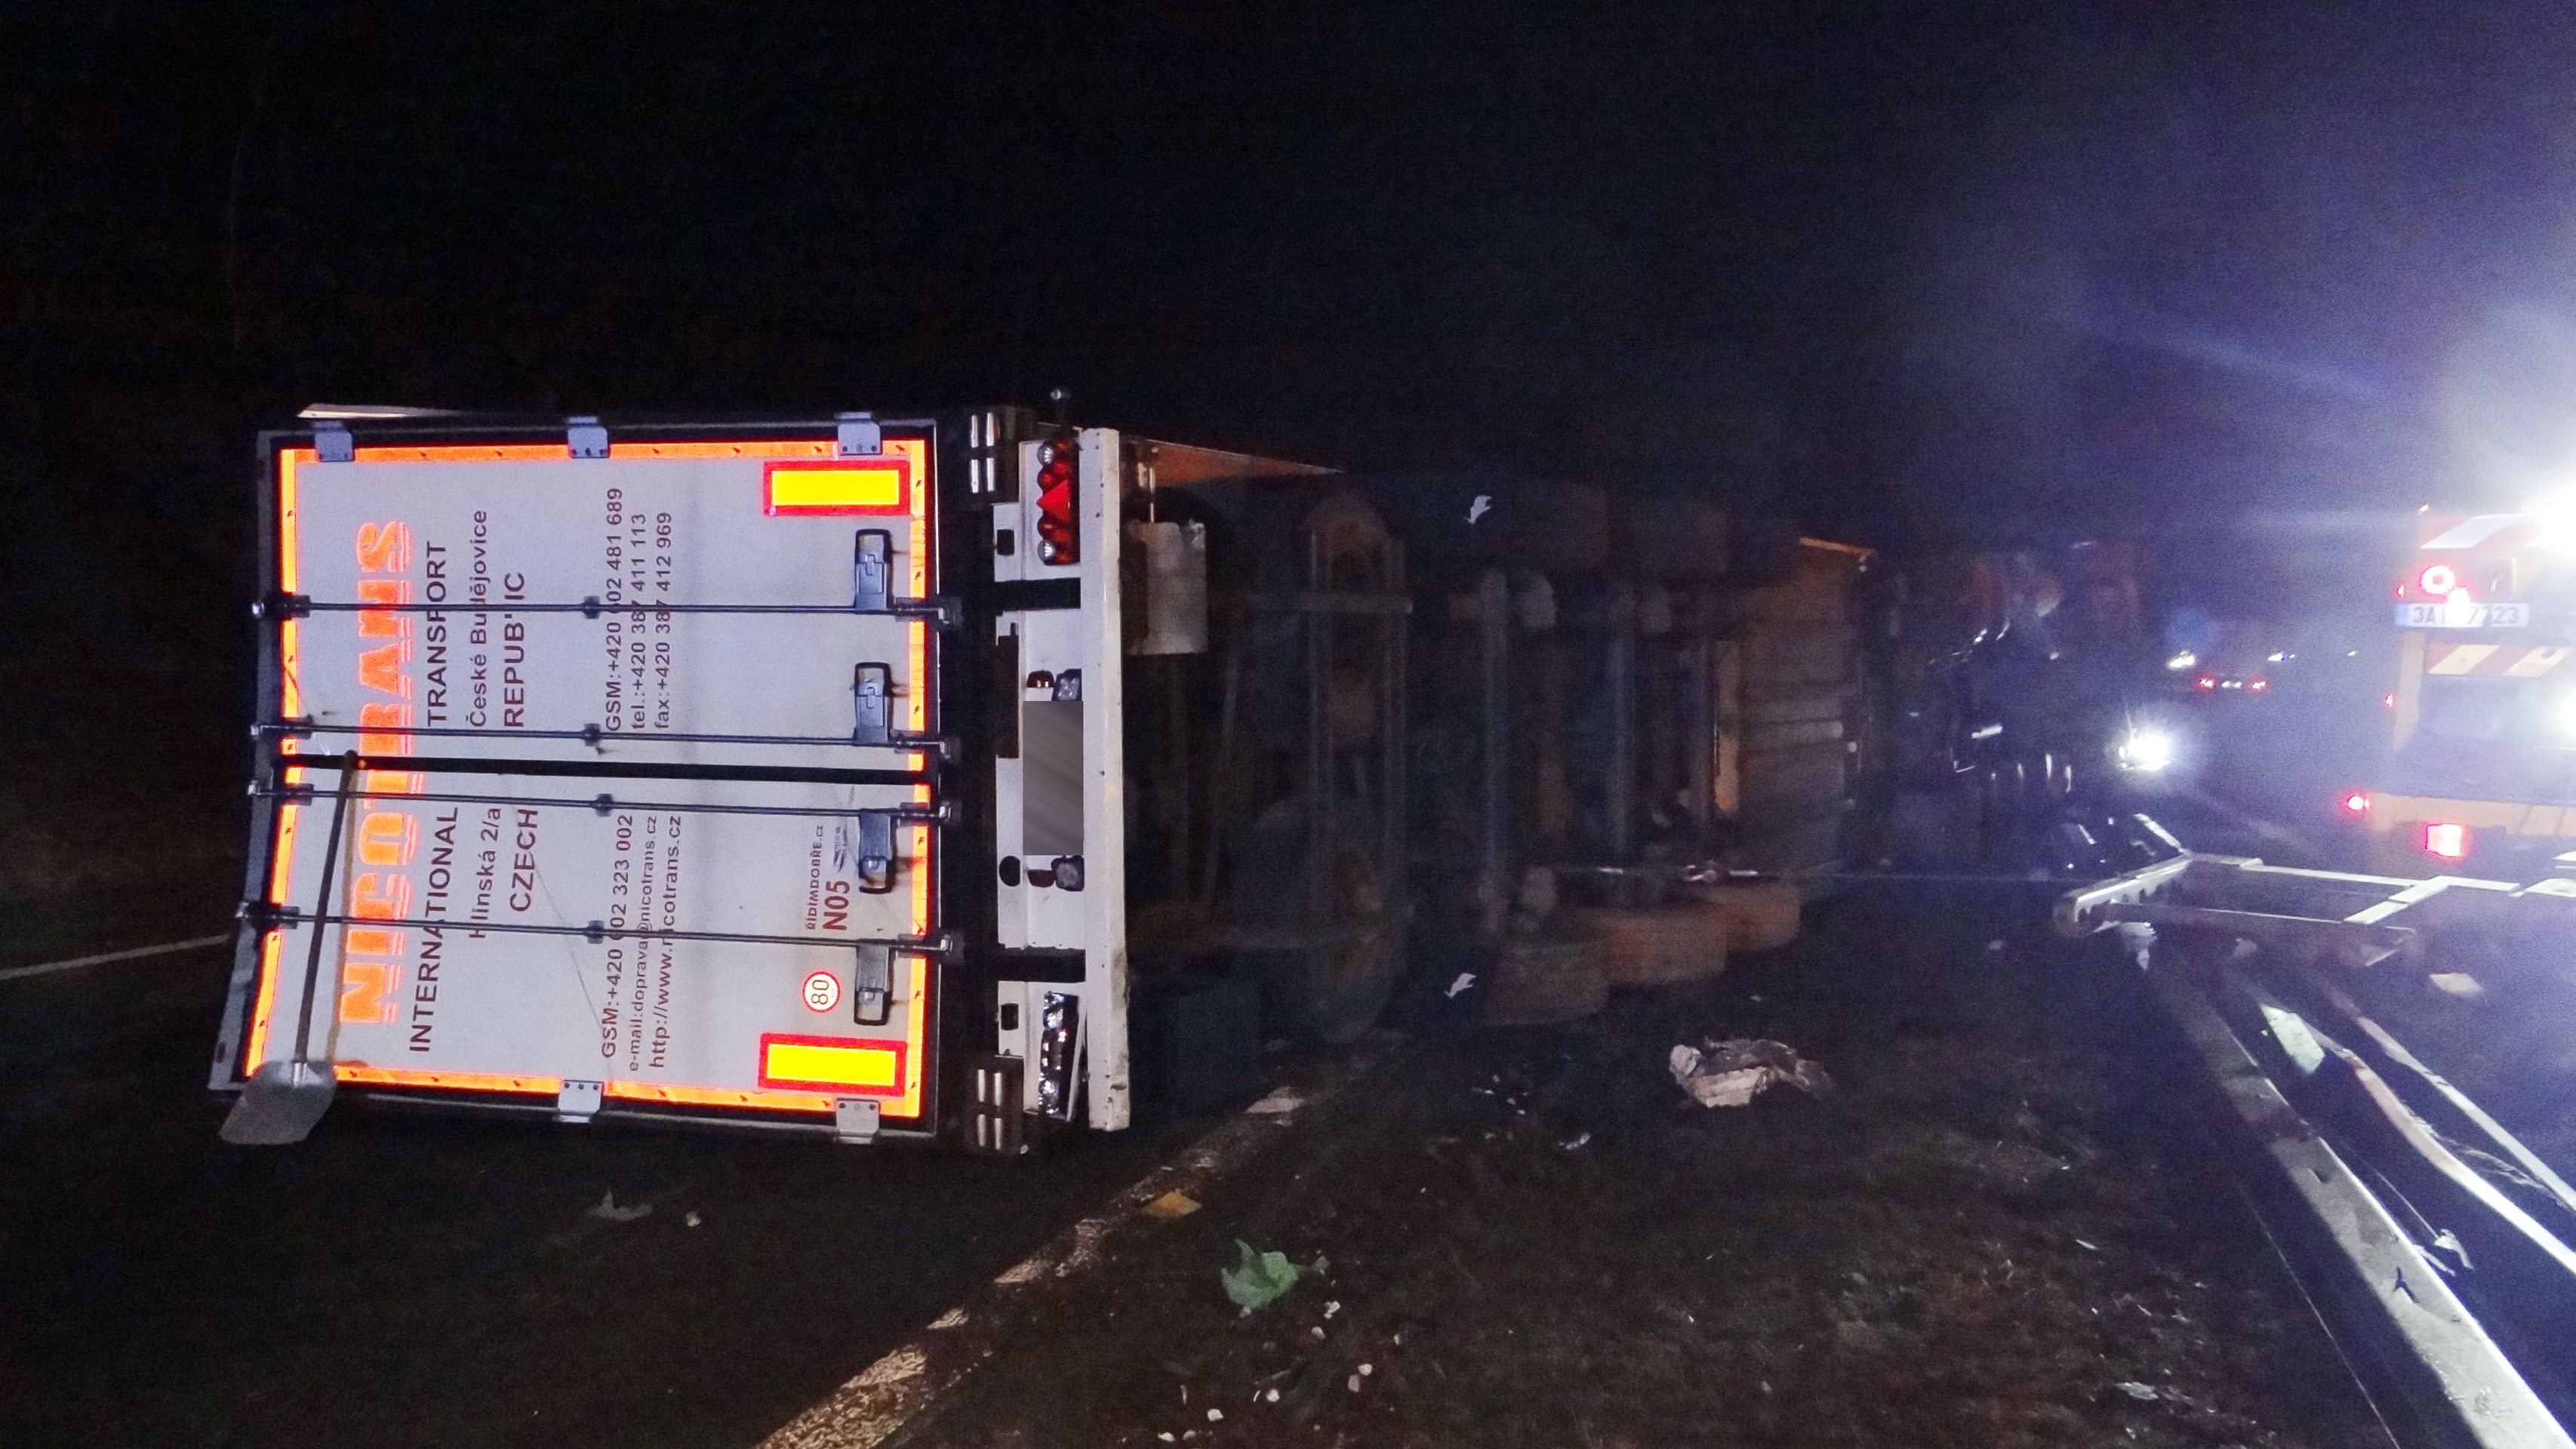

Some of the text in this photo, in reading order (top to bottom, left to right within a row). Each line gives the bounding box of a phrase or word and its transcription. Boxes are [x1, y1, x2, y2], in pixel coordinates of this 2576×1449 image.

[606, 488, 622, 525] 689
[631, 513, 646, 548] 113
[656, 512, 671, 549] 969
[606, 534, 622, 571] 481
[631, 558, 646, 592] 411
[655, 555, 671, 592] 412
[2413, 606, 2454, 625] 3A
[466, 654, 487, 727] České
[605, 622, 622, 731] GSM:+420
[630, 641, 646, 730] tel.:+420
[654, 641, 670, 730] fax:+420
[503, 571, 538, 912] CZECH REPUBIC
[339, 521, 424, 1023] NICOTRANS
[409, 540, 458, 1052] INTERNATIONAL TRANSPORT
[480, 808, 501, 841] 2/a
[616, 814, 632, 851] 002
[612, 859, 629, 895] 323
[822, 880, 850, 931] N05
[601, 949, 623, 1058] GSM:+420
[811, 980, 829, 1005] 80
